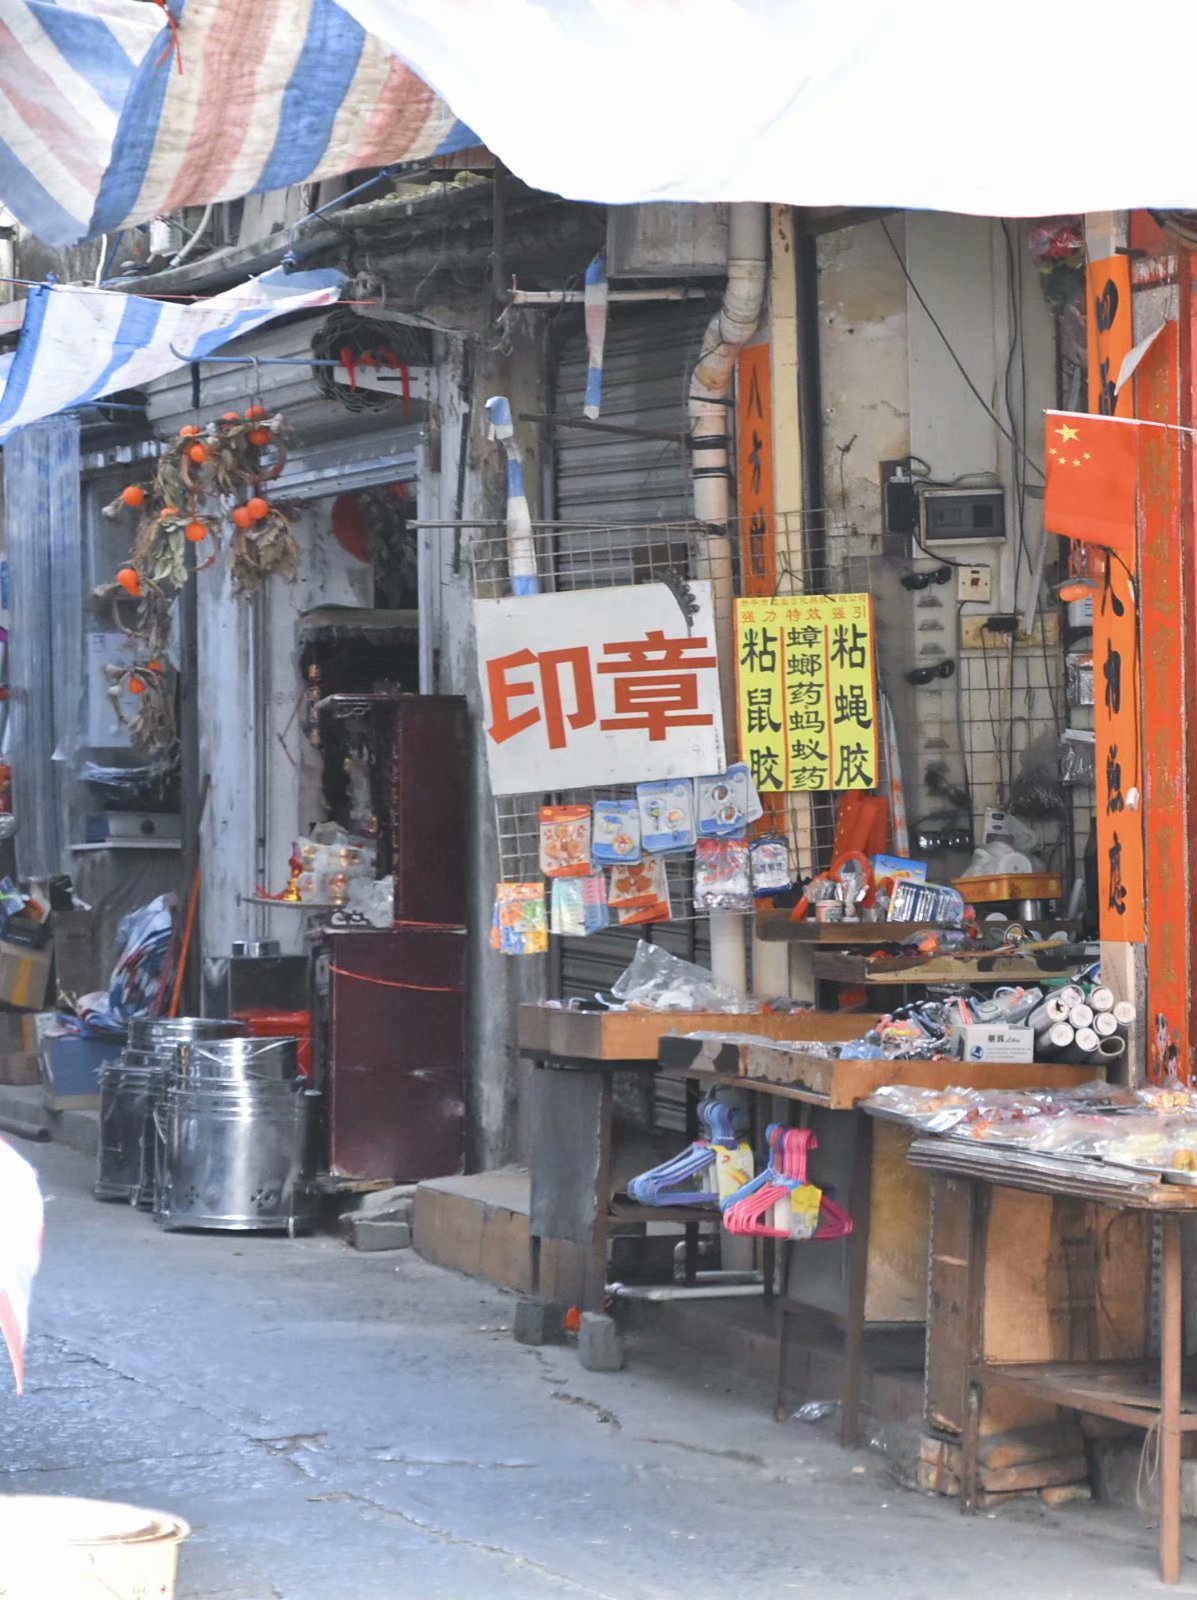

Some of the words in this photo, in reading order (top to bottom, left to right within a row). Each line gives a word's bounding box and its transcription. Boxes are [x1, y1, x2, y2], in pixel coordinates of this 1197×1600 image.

[486, 630, 717, 750] 印章
[741, 627, 784, 790] 粘鼠胶
[830, 623, 874, 788] 粘蝇胶
